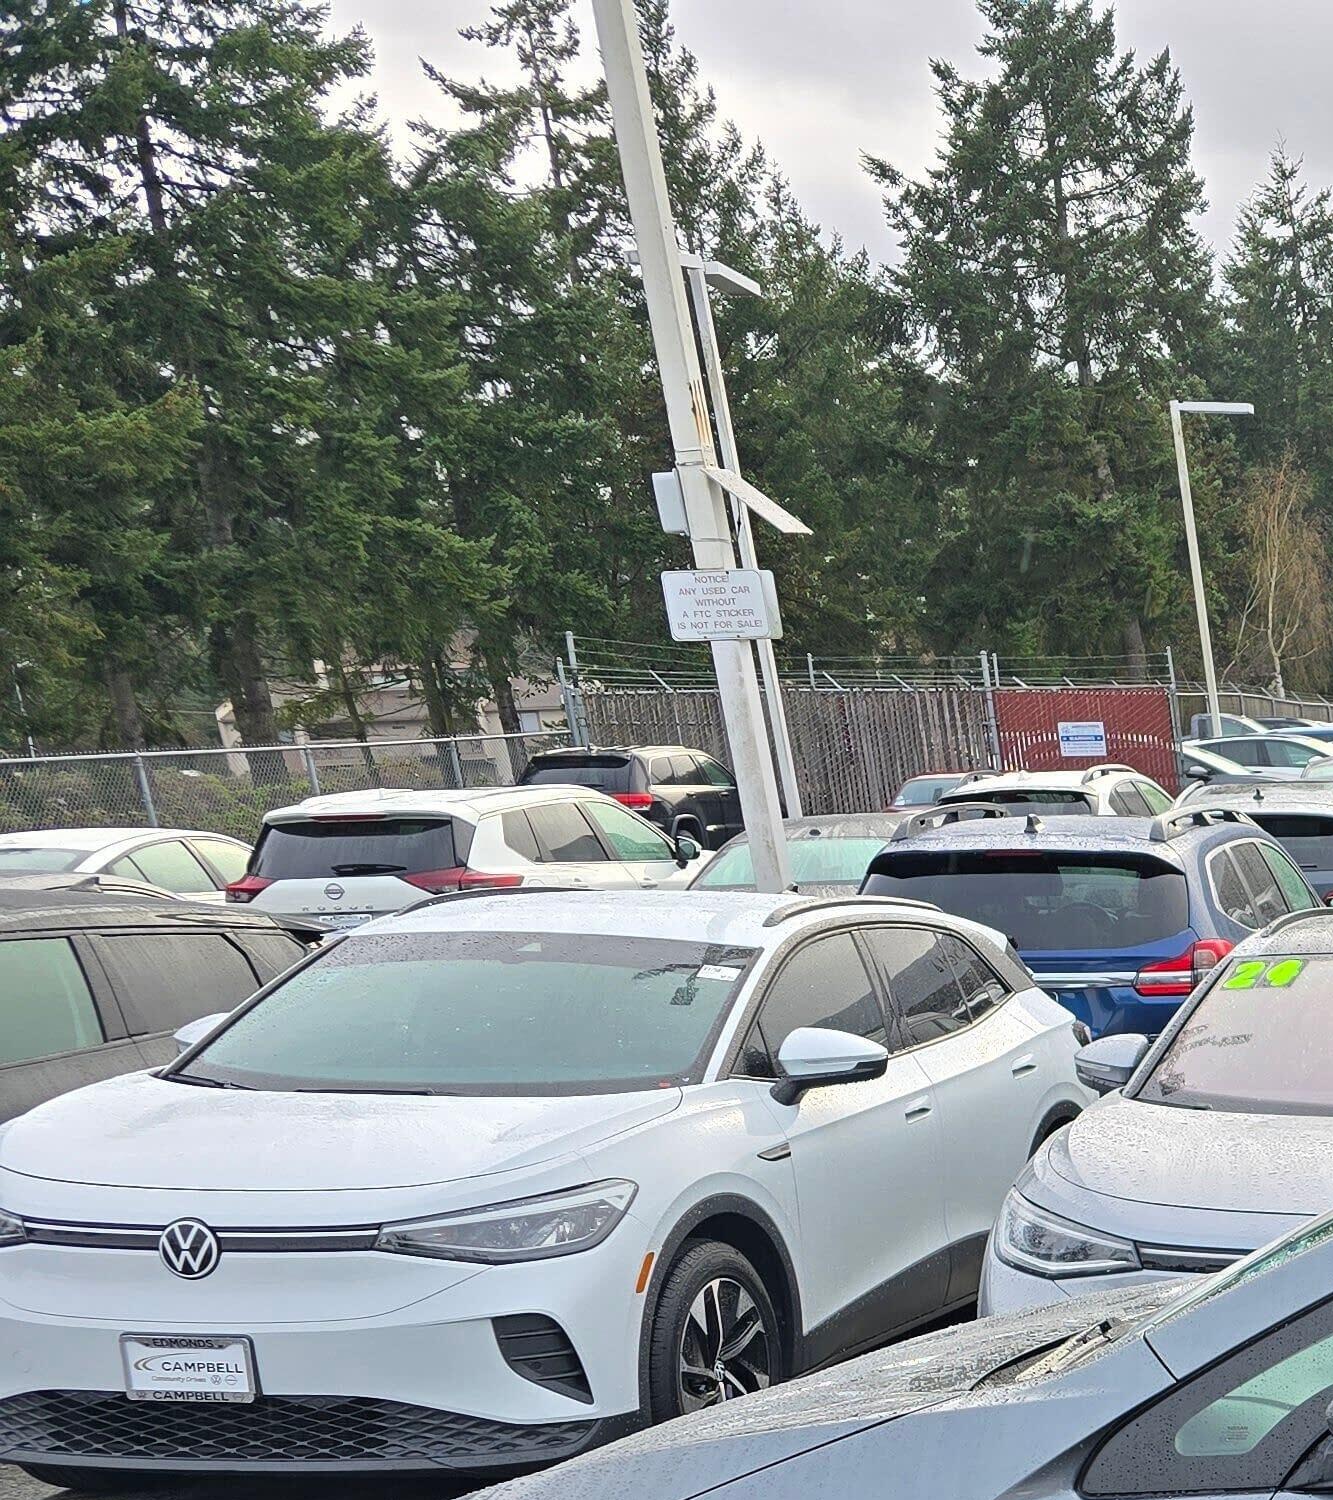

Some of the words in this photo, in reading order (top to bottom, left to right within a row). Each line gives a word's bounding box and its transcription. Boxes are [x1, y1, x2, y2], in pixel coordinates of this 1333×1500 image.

[694, 574, 729, 584] NOTICE!
[678, 587, 697, 596] ANY
[701, 586, 727, 595] USED
[730, 585, 751, 594] CAR
[695, 597, 737, 607] WITHOUT
[682, 610, 689, 619] A
[693, 609, 712, 618] FTC
[715, 608, 755, 618] STICKER
[677, 621, 686, 630] IS
[690, 621, 710, 630] NOT
[713, 620, 733, 629] FOR
[737, 619, 763, 628] SALE!
[1222, 958, 1304, 989] 24
[151, 1337, 215, 1348] EDMONDS
[161, 1361, 244, 1374] CAMPBELL
[152, 1390, 230, 1402] CAMPBELL
